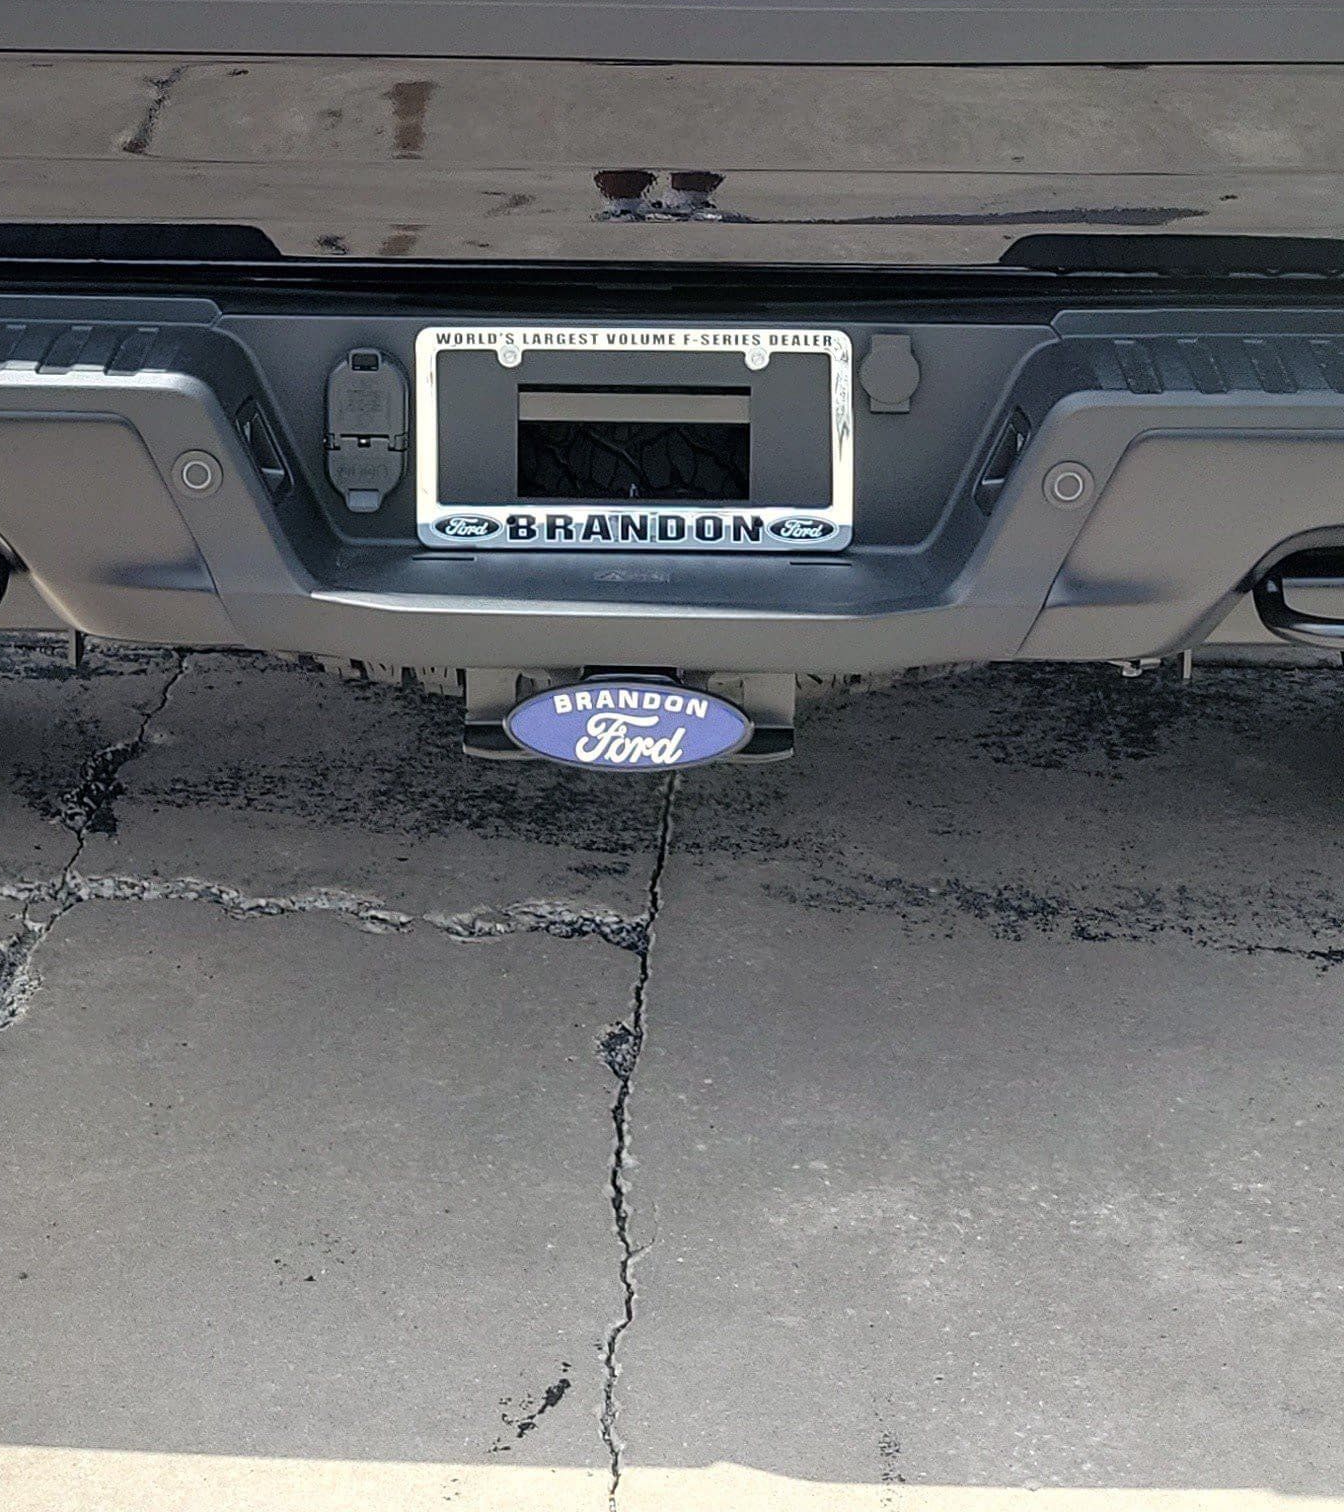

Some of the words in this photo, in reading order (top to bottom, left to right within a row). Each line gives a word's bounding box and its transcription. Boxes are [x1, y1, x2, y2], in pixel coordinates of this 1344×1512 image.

[436, 332, 514, 345] WORLD'S
[522, 332, 599, 345] LARGEST
[606, 333, 676, 345] VOLUME
[683, 334, 761, 346] F-SERIES
[769, 335, 832, 346] DEALER
[445, 517, 488, 535] Ford
[506, 514, 764, 543] BRANDON
[780, 519, 823, 538] Ford
[553, 690, 709, 719] BRANDON
[575, 712, 687, 764] Ford
